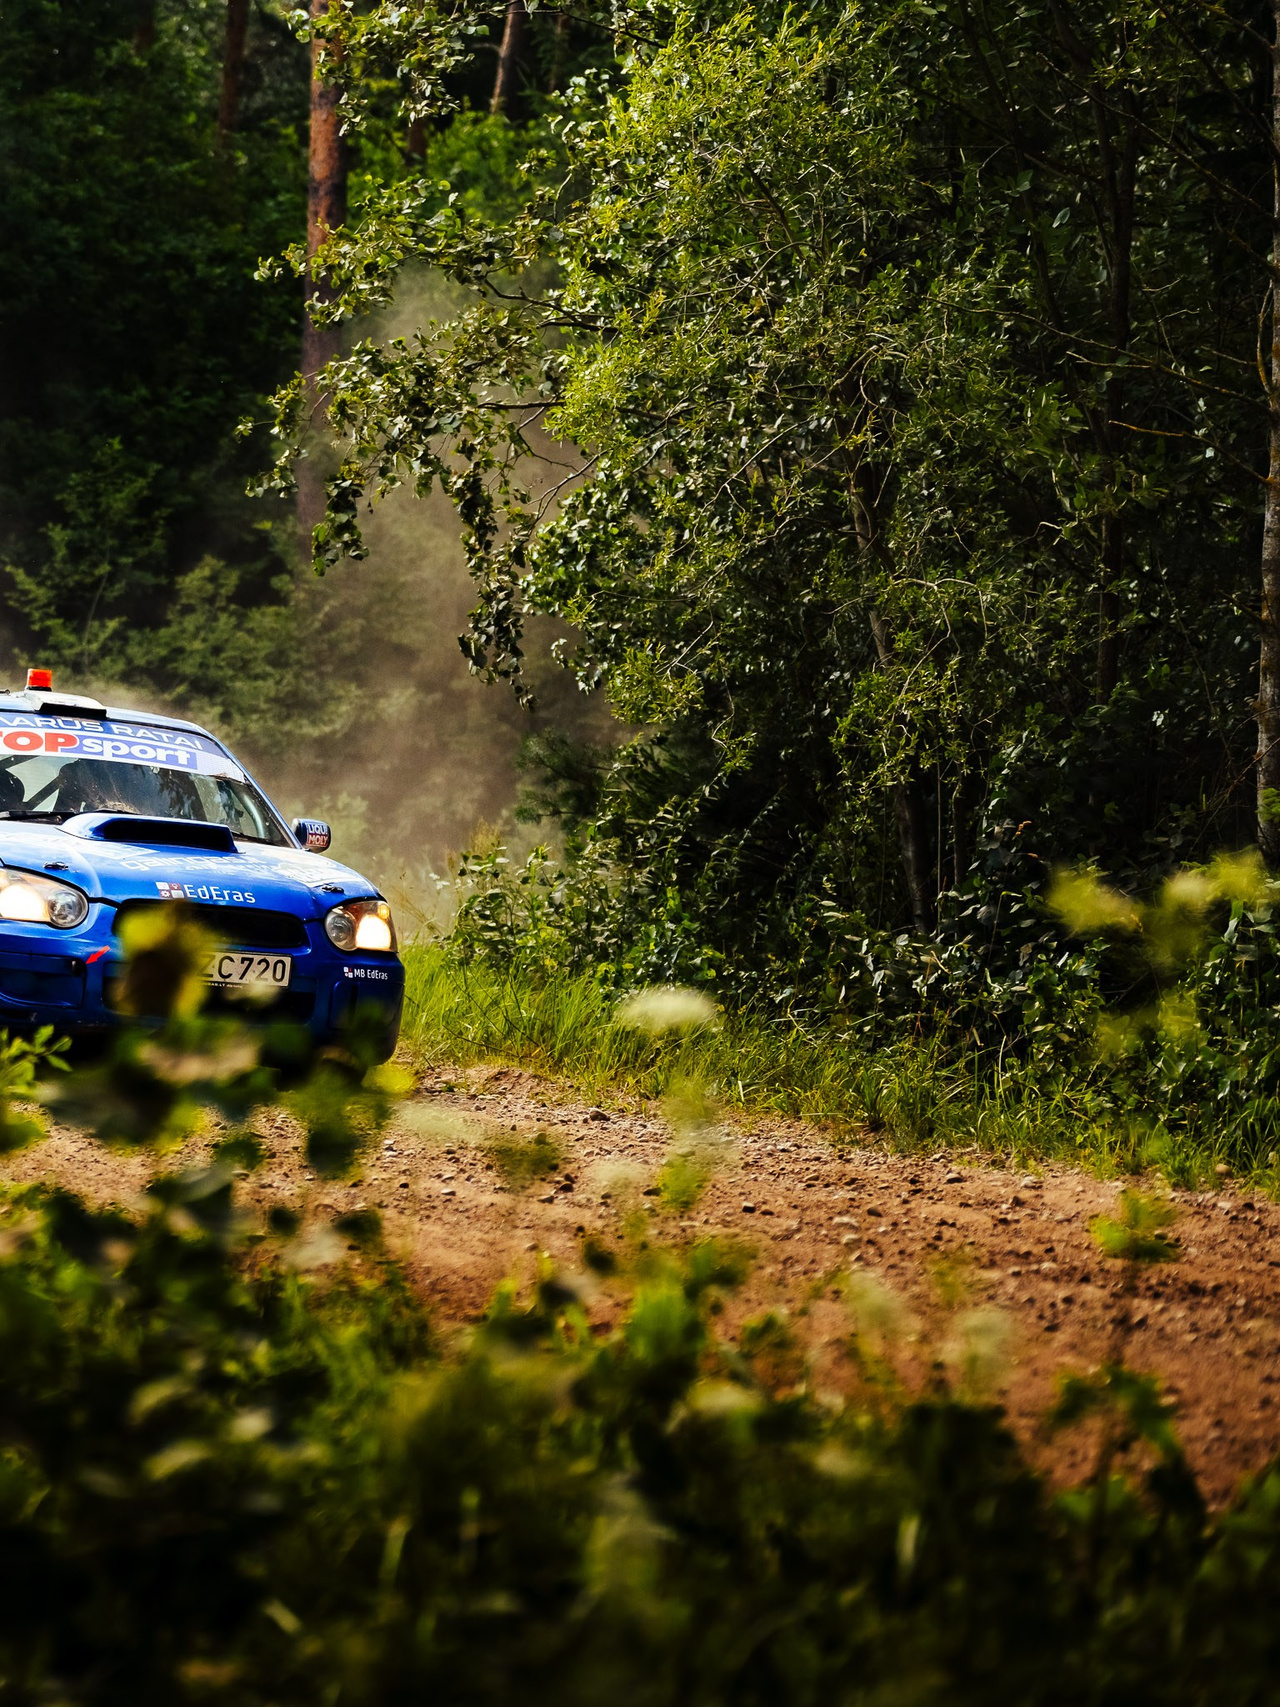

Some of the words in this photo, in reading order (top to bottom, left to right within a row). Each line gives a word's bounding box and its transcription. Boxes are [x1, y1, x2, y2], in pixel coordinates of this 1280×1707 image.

[110, 724, 203, 750] RATAI
[308, 824, 328, 835] LIQUI
[308, 834, 329, 845] MOLY
[183, 884, 256, 904] EdEras
[354, 968, 366, 978] MB
[367, 969, 388, 980] EdEras
